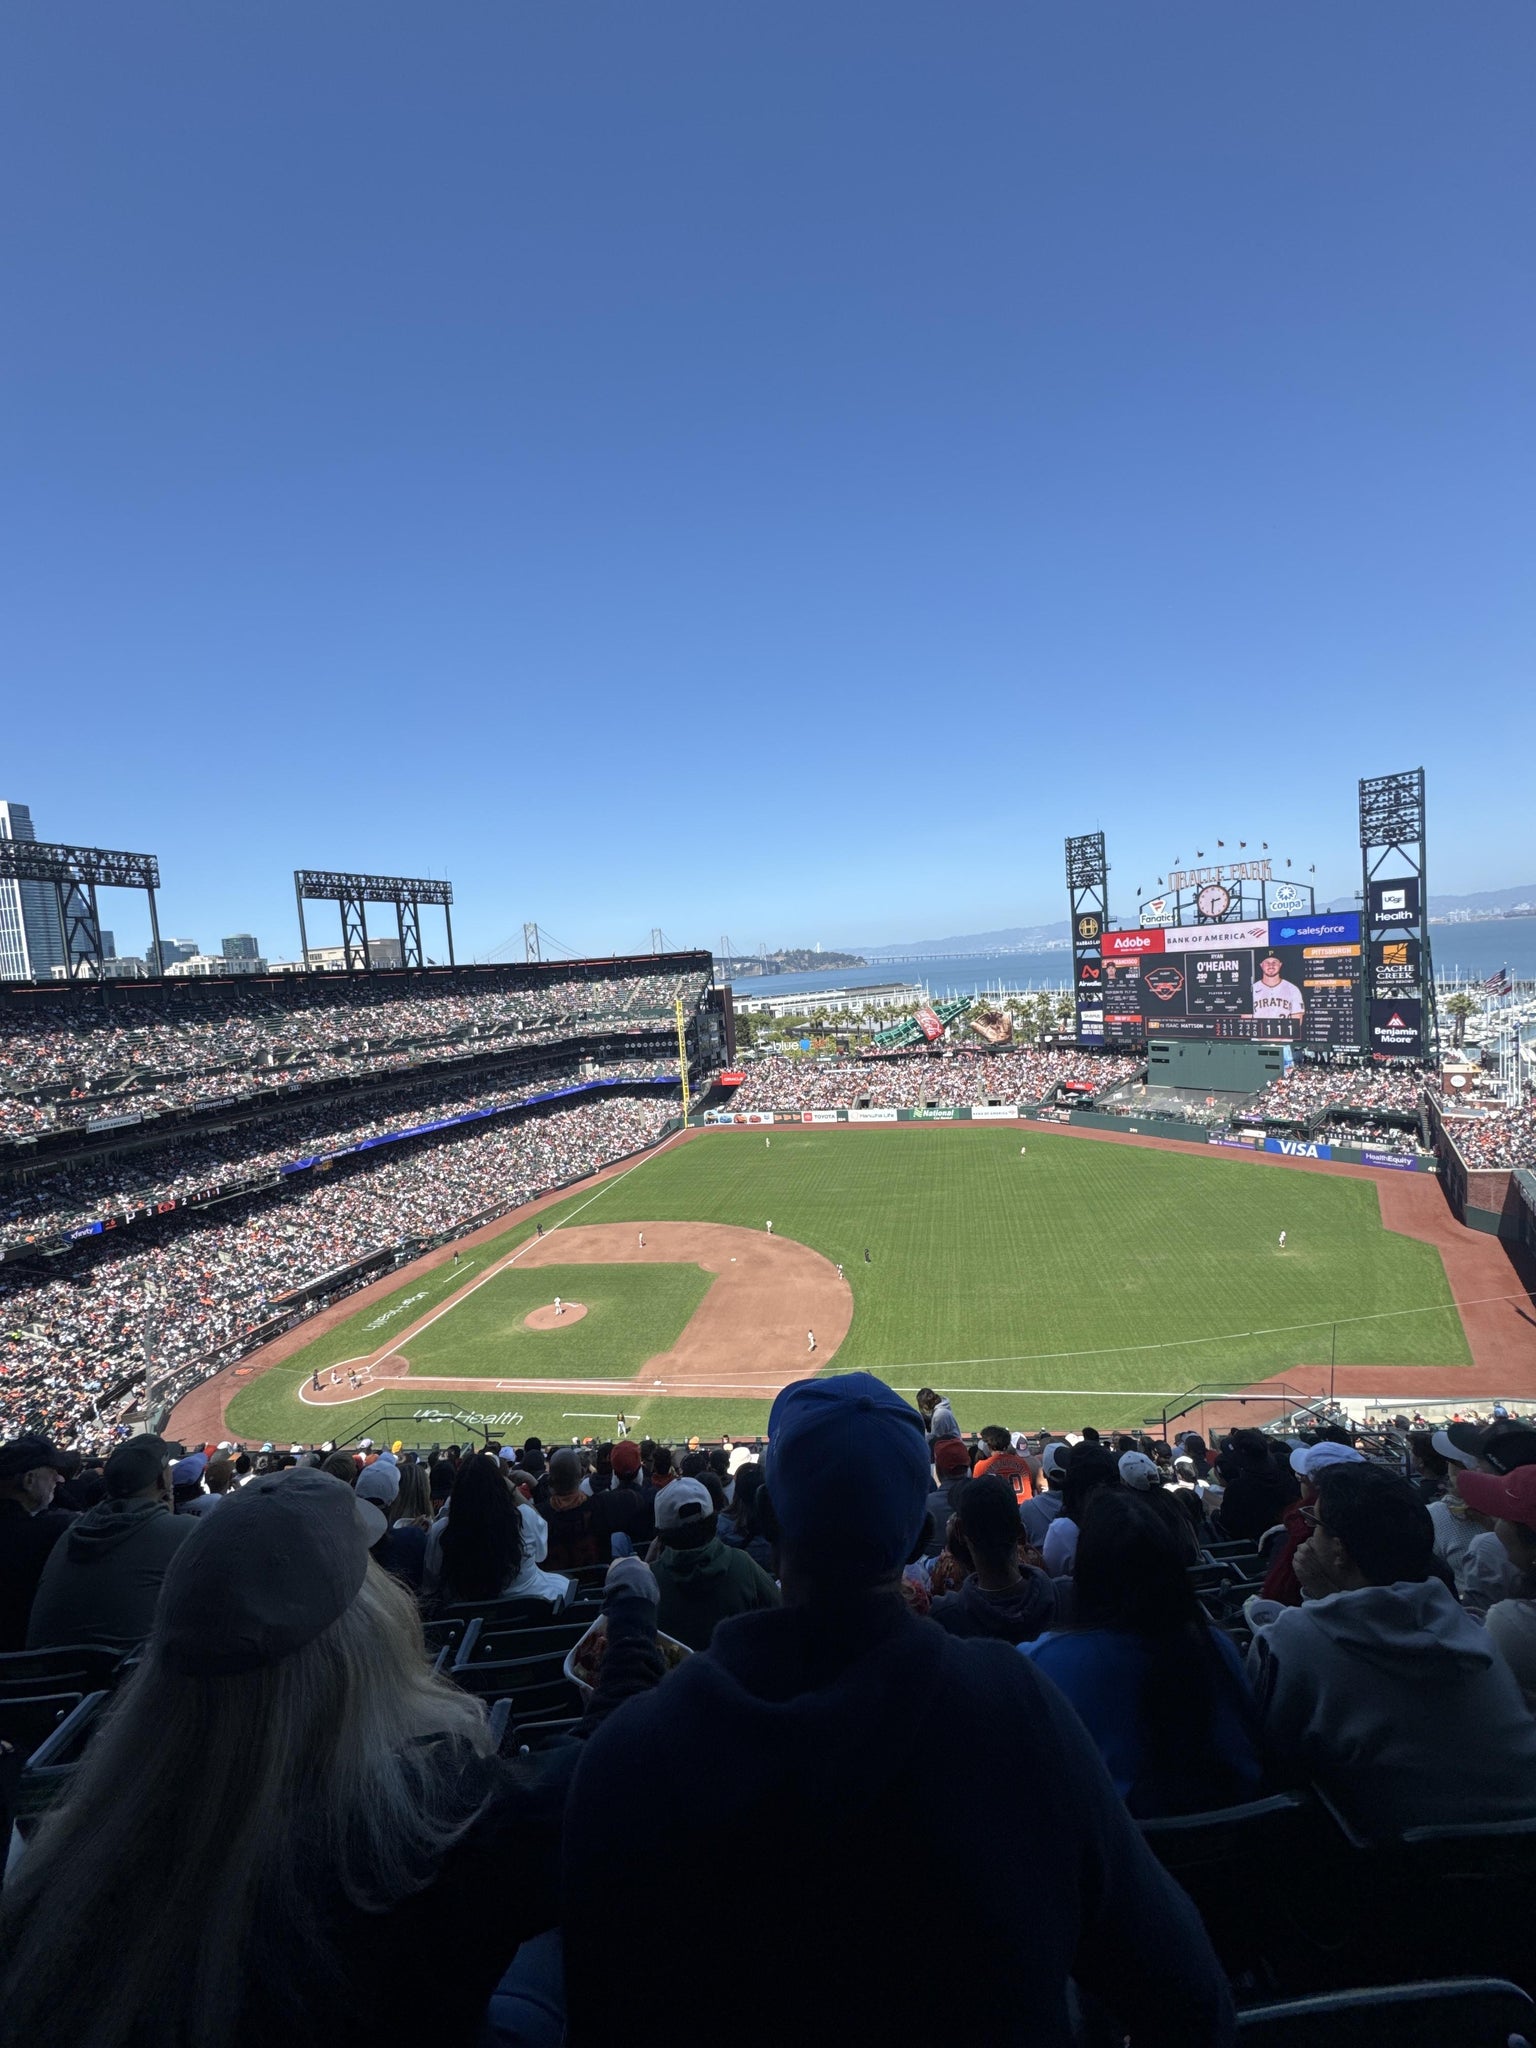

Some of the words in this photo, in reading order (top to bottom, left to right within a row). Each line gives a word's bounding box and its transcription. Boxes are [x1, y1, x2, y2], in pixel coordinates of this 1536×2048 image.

[1168, 867, 1225, 891] ORACLE
[1229, 859, 1272, 880] PARK
[1272, 901, 1300, 910] coupa
[1142, 914, 1175, 923] Fanatics
[1375, 911, 1412, 921] Health
[1297, 925, 1345, 936] salesforce
[1114, 937, 1151, 948] Adobe
[1167, 936, 1189, 944] BANK
[1204, 933, 1246, 942] AMERICA
[1197, 960, 1239, 972] O'HEARN
[1266, 1025, 1271, 1035] 1
[1277, 1025, 1281, 1035] 1
[1288, 1025, 1292, 1035] 1
[1374, 1027, 1418, 1036] Benjamin
[773, 1040, 799, 1050] blue
[923, 1109, 954, 1117] National
[1276, 1140, 1319, 1158] VISA
[1365, 1153, 1413, 1165] HealthEquity
[181, 1198, 187, 1206] 2
[70, 1228, 93, 1240] xfinity
[454, 1411, 523, 1425] Health
